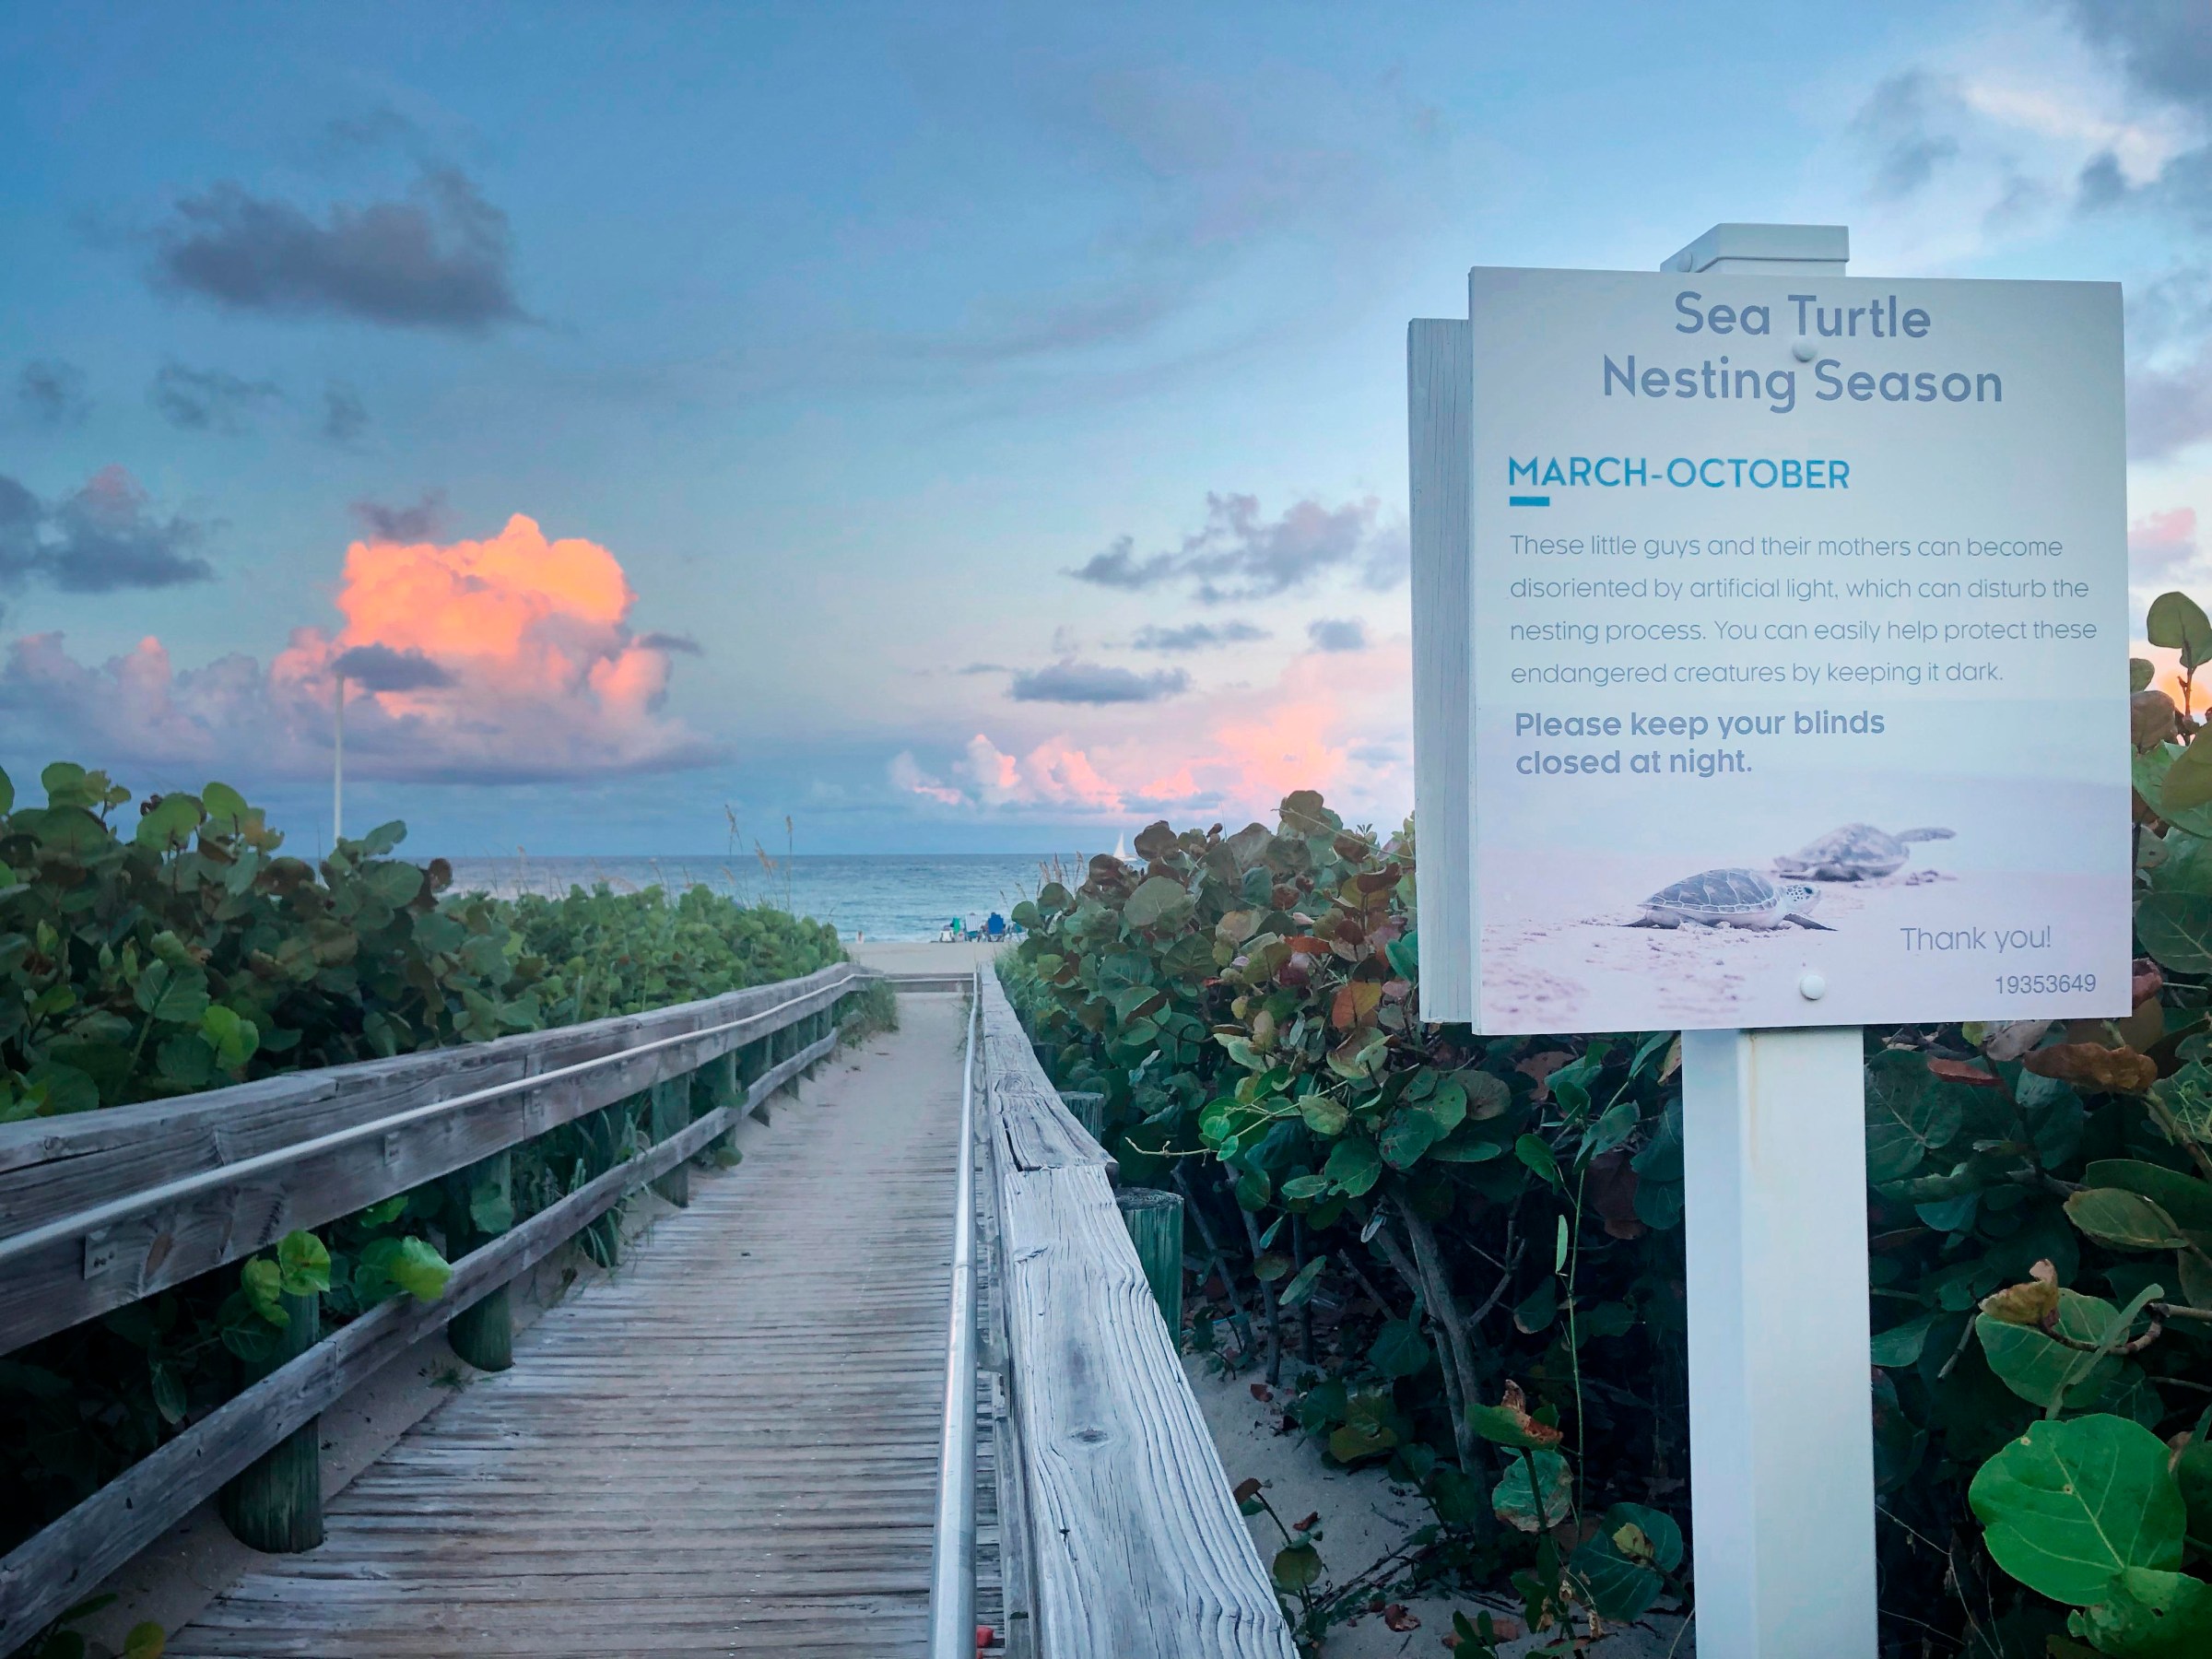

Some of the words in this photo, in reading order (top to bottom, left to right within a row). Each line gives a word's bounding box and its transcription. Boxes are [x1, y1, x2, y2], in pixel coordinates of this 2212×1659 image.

[1676, 291, 1770, 335] Sea
[1788, 295, 1931, 337] Turtle
[1604, 354, 1796, 414] Nesting
[1815, 359, 2003, 402] Season
[1508, 455, 1850, 489] MARCH-OCTOBER
[1510, 535, 1583, 555] These
[1592, 535, 1636, 555] little
[1644, 539, 1700, 559] guys
[1708, 536, 1754, 555] and
[1761, 536, 1811, 556] their
[1818, 537, 1911, 556] mothers
[1918, 541, 1959, 556] can
[1968, 538, 2063, 556] become
[1511, 578, 1646, 597] disoriented
[1654, 578, 1683, 601] by
[1690, 578, 1779, 597] artificial
[1787, 579, 1838, 602] light,
[1846, 579, 1911, 597] which
[1919, 582, 1960, 597] can
[1968, 579, 2046, 597] disturb
[2053, 579, 2088, 597] the
[1512, 621, 1598, 644] nesting
[1606, 625, 1706, 644] process.
[1714, 621, 1757, 640] You
[1765, 625, 1806, 640] can
[1815, 620, 1880, 643] easily
[1888, 620, 1937, 643] help
[1945, 621, 2027, 642] protect
[2033, 620, 2097, 639] these
[1512, 664, 1666, 687] endangered
[1675, 665, 1785, 682] creatures
[1794, 663, 1820, 686] by
[1828, 663, 1921, 685] keeping
[1928, 662, 1939, 681] it
[1947, 662, 2003, 680] dark.
[1516, 712, 1621, 736] Please
[1631, 712, 1708, 740] keep
[1718, 715, 1786, 739] your
[1794, 709, 1885, 735] blinds
[1516, 750, 1620, 774] closed
[1630, 751, 1661, 773] at
[1670, 748, 1751, 778] night.
[1900, 926, 1986, 950] Thank
[1994, 925, 2051, 953] you!
[1995, 974, 2096, 994] 19353649
